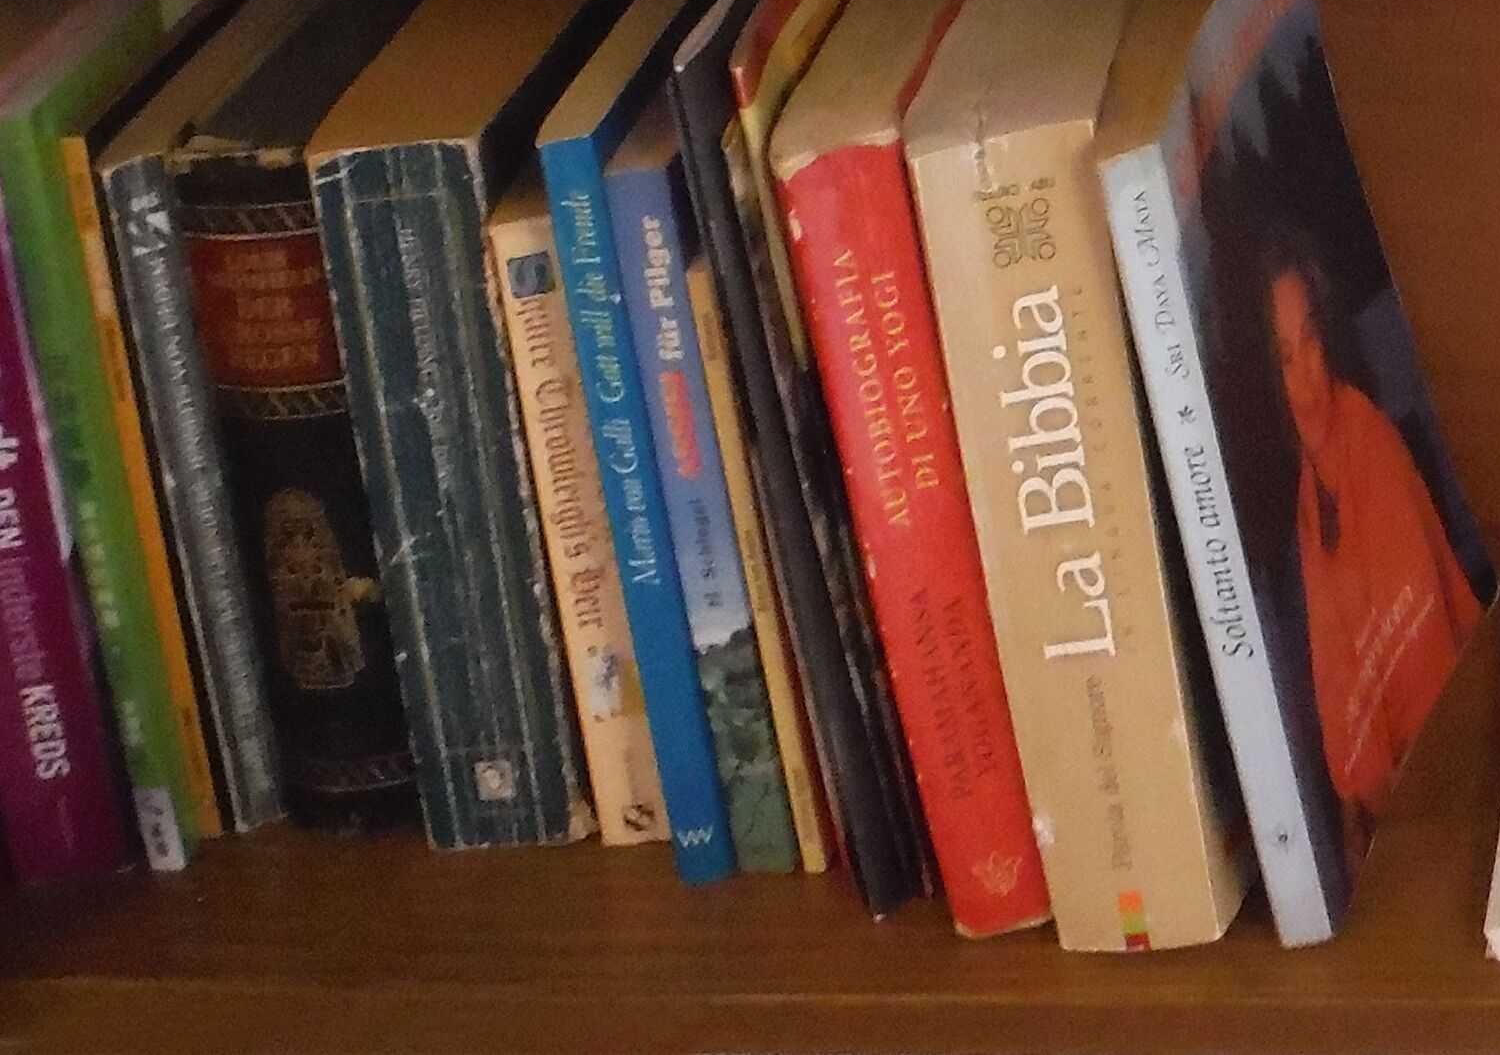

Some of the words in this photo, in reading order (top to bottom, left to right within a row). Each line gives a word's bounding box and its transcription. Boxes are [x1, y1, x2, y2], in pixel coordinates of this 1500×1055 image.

[633, 213, 678, 309] Pilger
[651, 314, 685, 363] für
[870, 270, 912, 357] YOGI
[830, 248, 912, 529] AUTOBIOGRAFIA
[891, 365, 930, 445] UNO
[991, 285, 1096, 537] Bibbia
[910, 453, 940, 491] DI
[1179, 441, 1224, 532] amore
[1043, 551, 1116, 660] La
[1195, 534, 1254, 663] Soltanto
[20, 683, 71, 781] KREDS
